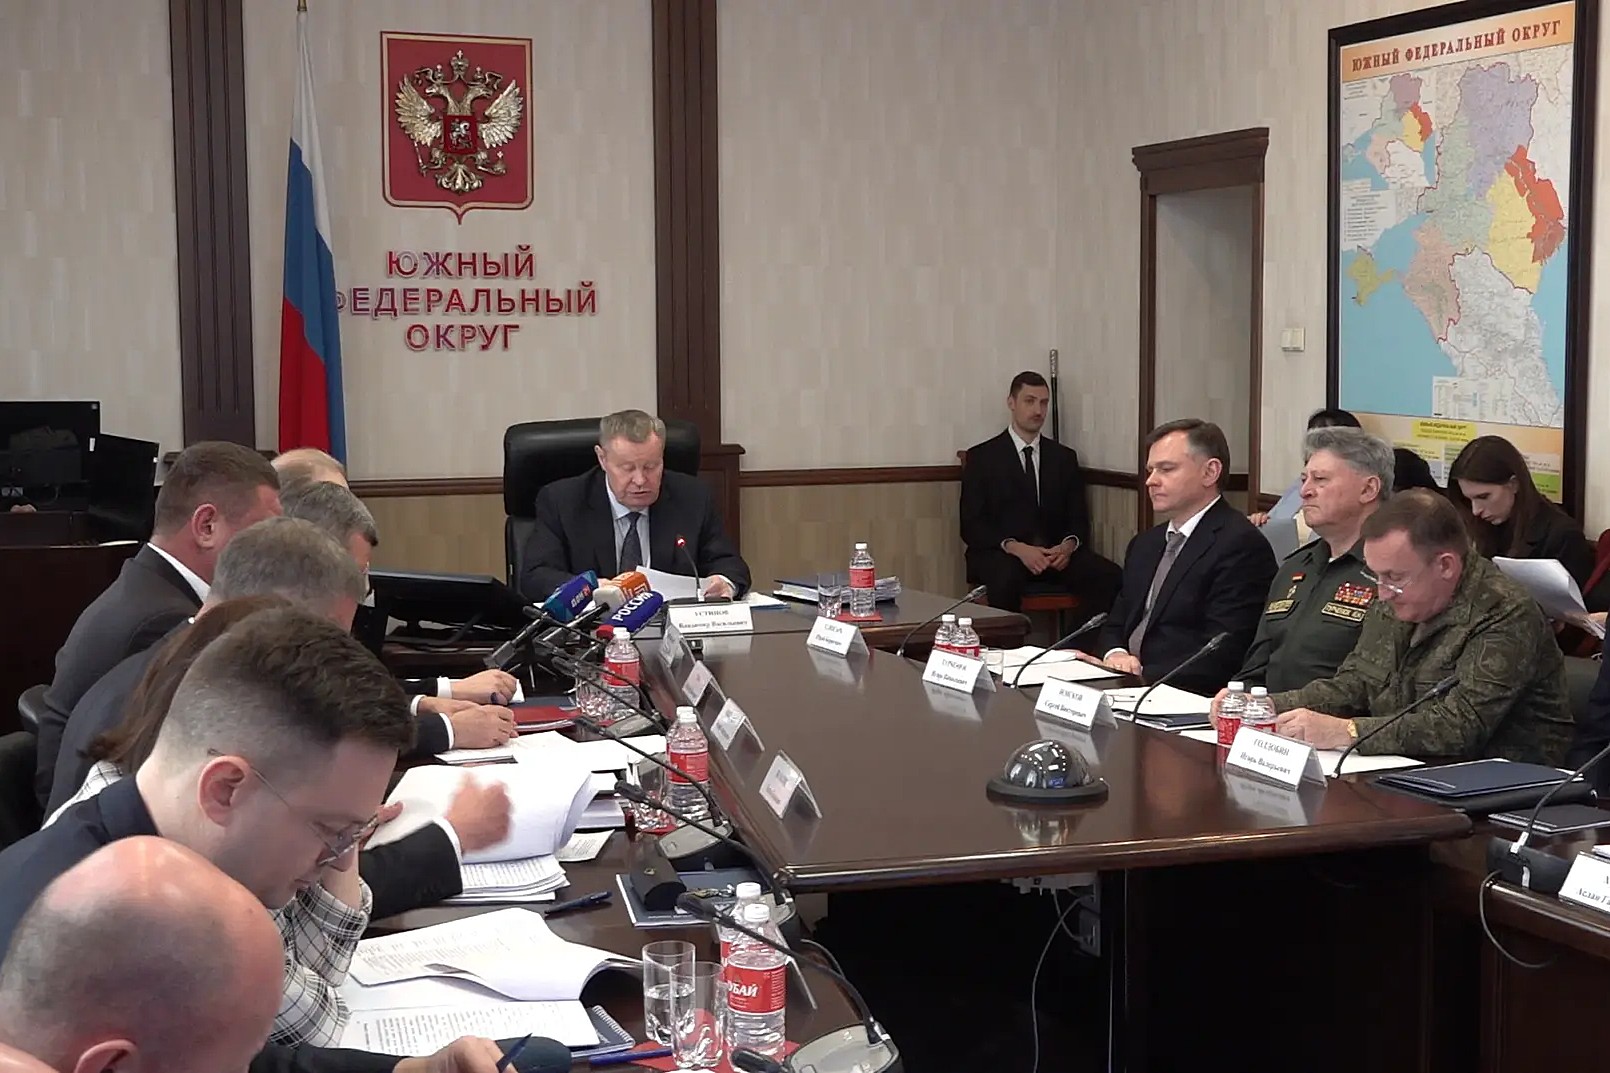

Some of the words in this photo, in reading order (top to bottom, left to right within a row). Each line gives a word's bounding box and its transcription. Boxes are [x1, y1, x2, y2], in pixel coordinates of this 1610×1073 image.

[1352, 48, 1399, 72] ЮЖНЫЙ
[1405, 27, 1506, 62] ФЕДЕРАЛЬНЫЙ
[1512, 20, 1561, 43] ОКРУГ
[386, 244, 536, 278] ЮЖНЫЙ
[405, 323, 520, 351] ОКРУГ
[611, 591, 654, 622] РОССИЯ
